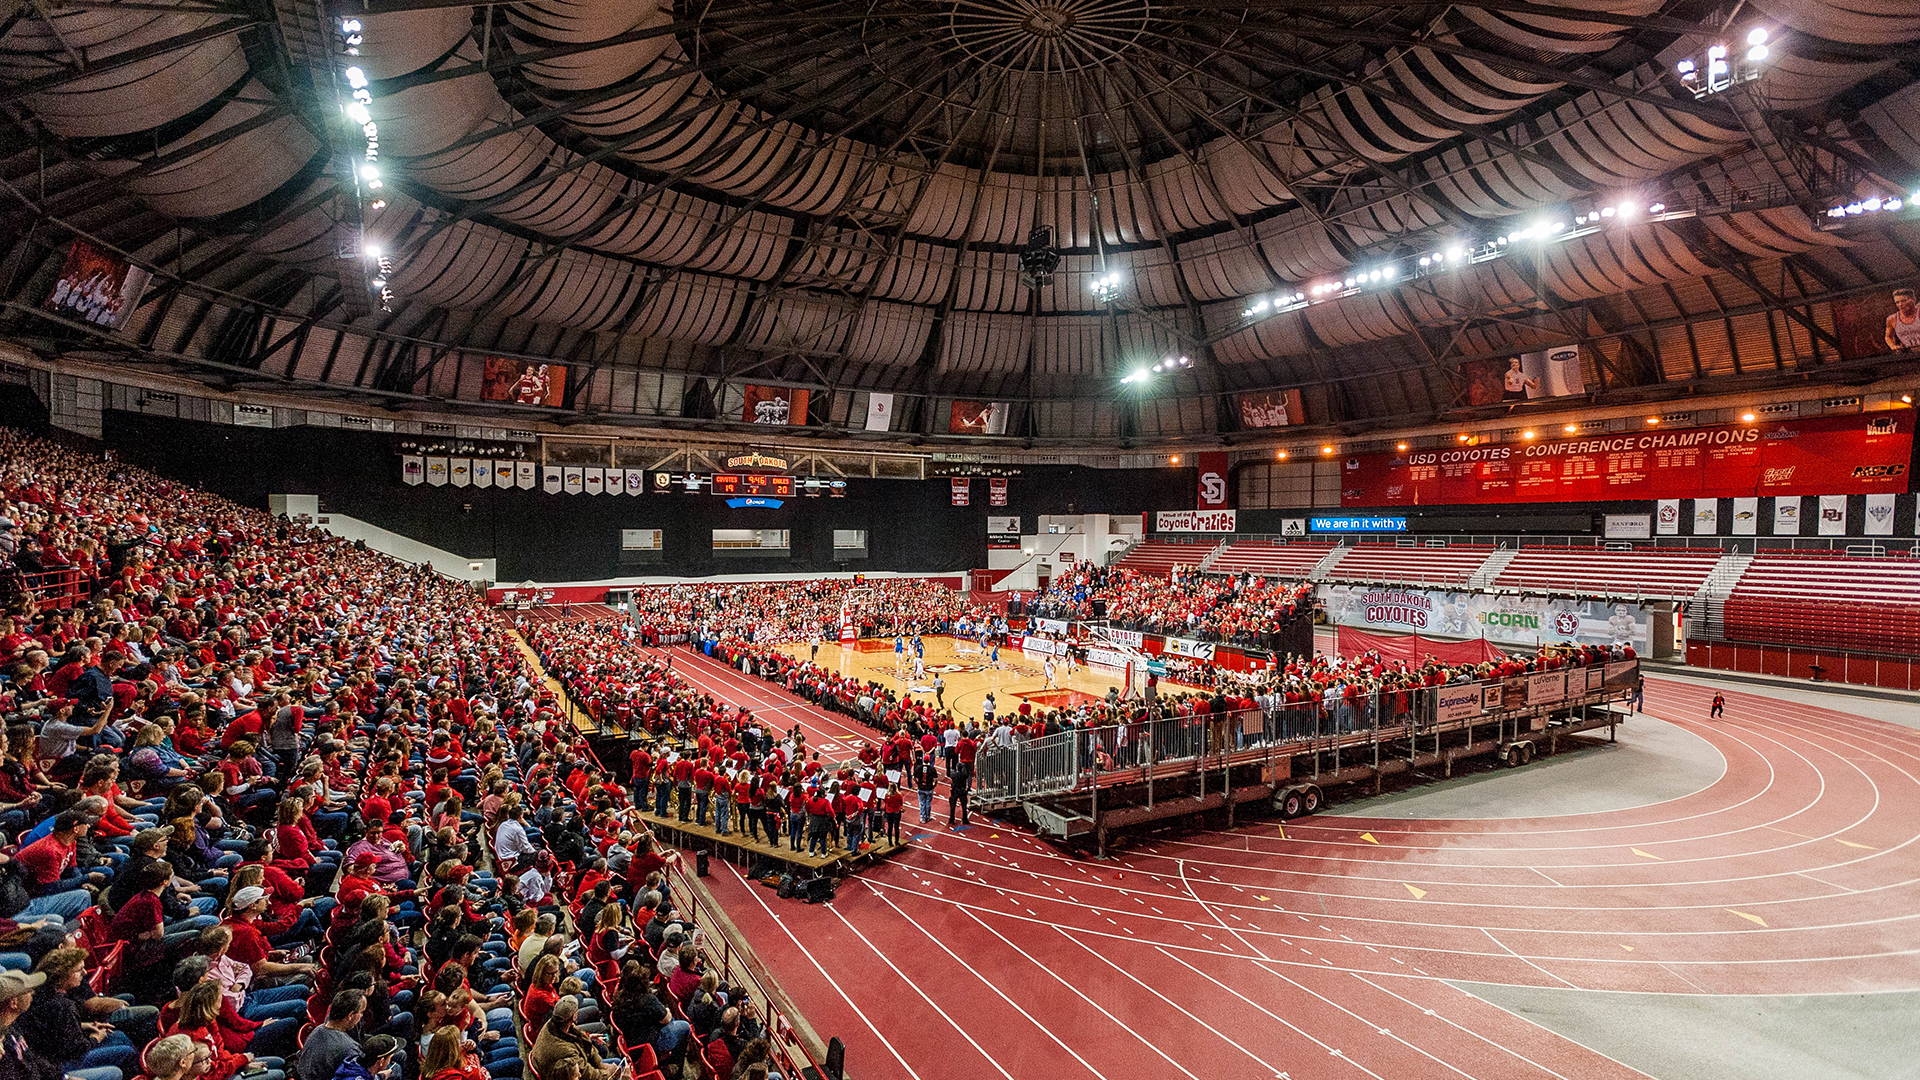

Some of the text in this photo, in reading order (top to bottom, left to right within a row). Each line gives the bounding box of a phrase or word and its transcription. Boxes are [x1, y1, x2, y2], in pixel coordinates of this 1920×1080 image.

[1867, 421, 1898, 435] VALLEY
[1409, 453, 1437, 465] USD
[1441, 447, 1511, 463] COYOTES
[1525, 437, 1635, 457] CONFERENCE
[1639, 428, 1760, 448] CHAMPIONS
[728, 455, 788, 470] SOUTH DAKOTA
[716, 475, 739, 484] COYOTES
[725, 484, 735, 493] 19
[776, 485, 788, 494] 20
[1200, 472, 1226, 504] SD
[1158, 511, 1234, 531] Coyote Crazies
[1315, 519, 1331, 528] We
[1350, 519, 1360, 528] in
[1362, 519, 1369, 528] it
[1372, 519, 1394, 528] with
[1362, 592, 1432, 610] SOUTH DAKOTA
[1367, 605, 1427, 627] COYOTES
[1487, 611, 1539, 629] CORN
[1111, 630, 1136, 641] COYOTE
[1439, 693, 1479, 709] ExpressAg
